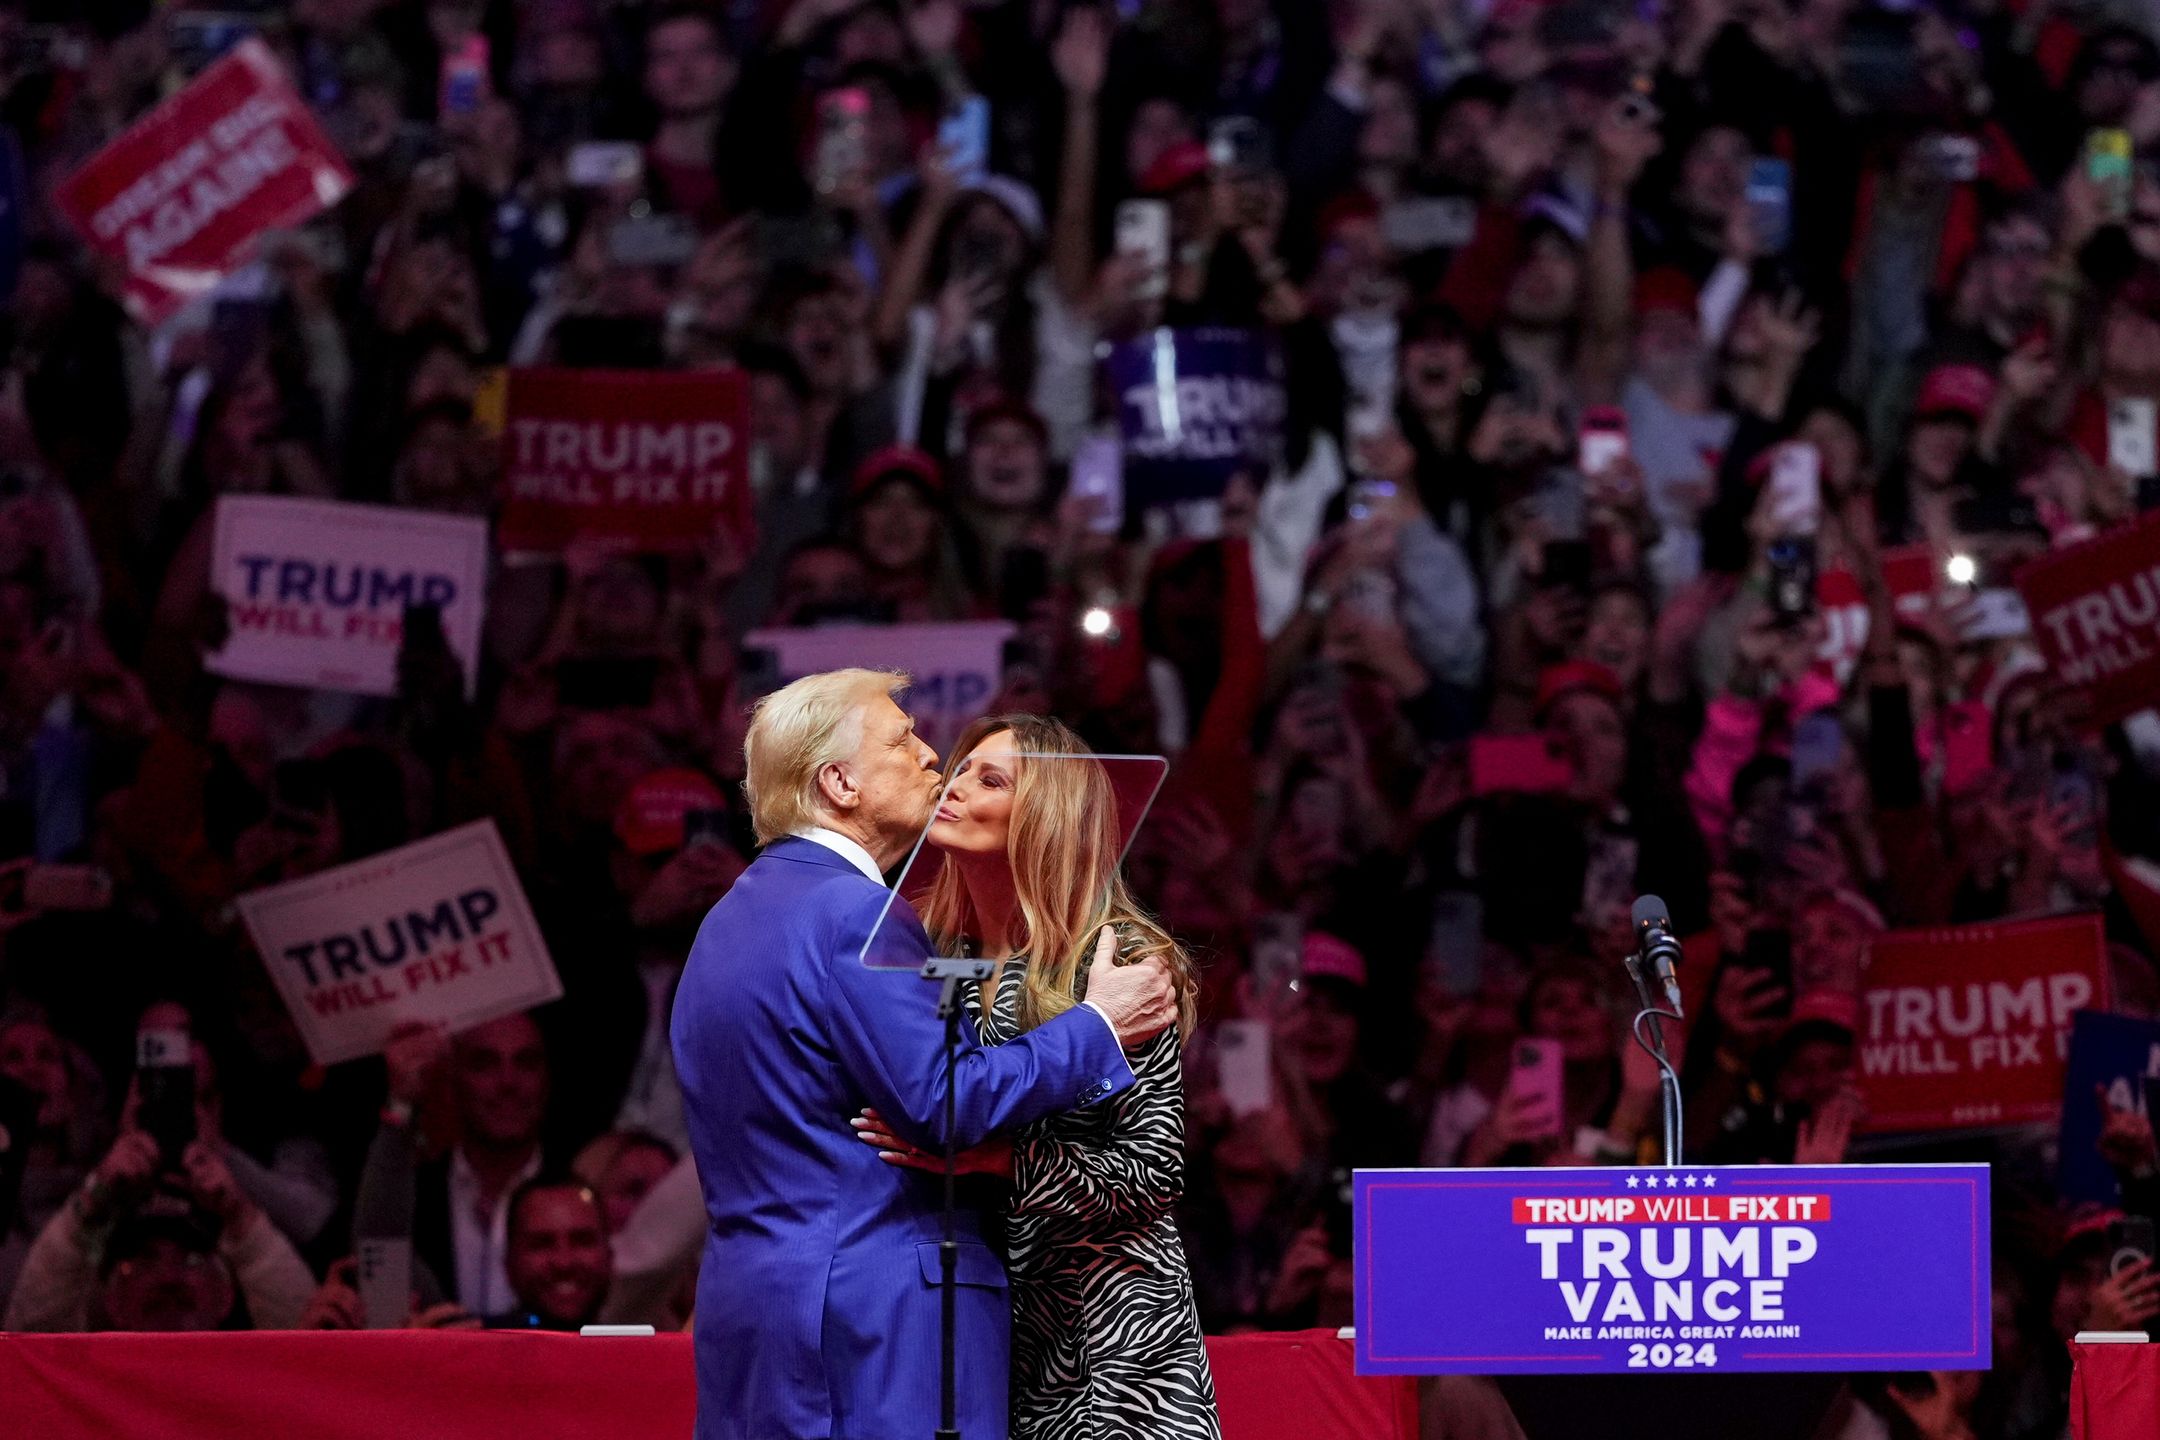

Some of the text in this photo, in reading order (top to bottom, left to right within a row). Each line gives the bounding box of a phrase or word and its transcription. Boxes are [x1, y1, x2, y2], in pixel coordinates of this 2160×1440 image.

[512, 418, 735, 471] TRUMP
[238, 556, 456, 608] TRUMP
[235, 605, 329, 637] WILL
[2041, 565, 2160, 655] TRU
[284, 890, 496, 985] TRUMP
[306, 932, 510, 1015] WILL FIX IT
[1865, 972, 2091, 1038] TRUMP
[1860, 1028, 2074, 1077] WILL FIX I
[1525, 1196, 1817, 1223] TRUMP WILL FIX IT
[1525, 1226, 1818, 1280] TRUMP
[1558, 1279, 1785, 1322] VANCE
[1544, 1325, 1800, 1340] MAKE AMERICA GREAT AGAIN!
[1628, 1342, 1717, 1368] 2024
